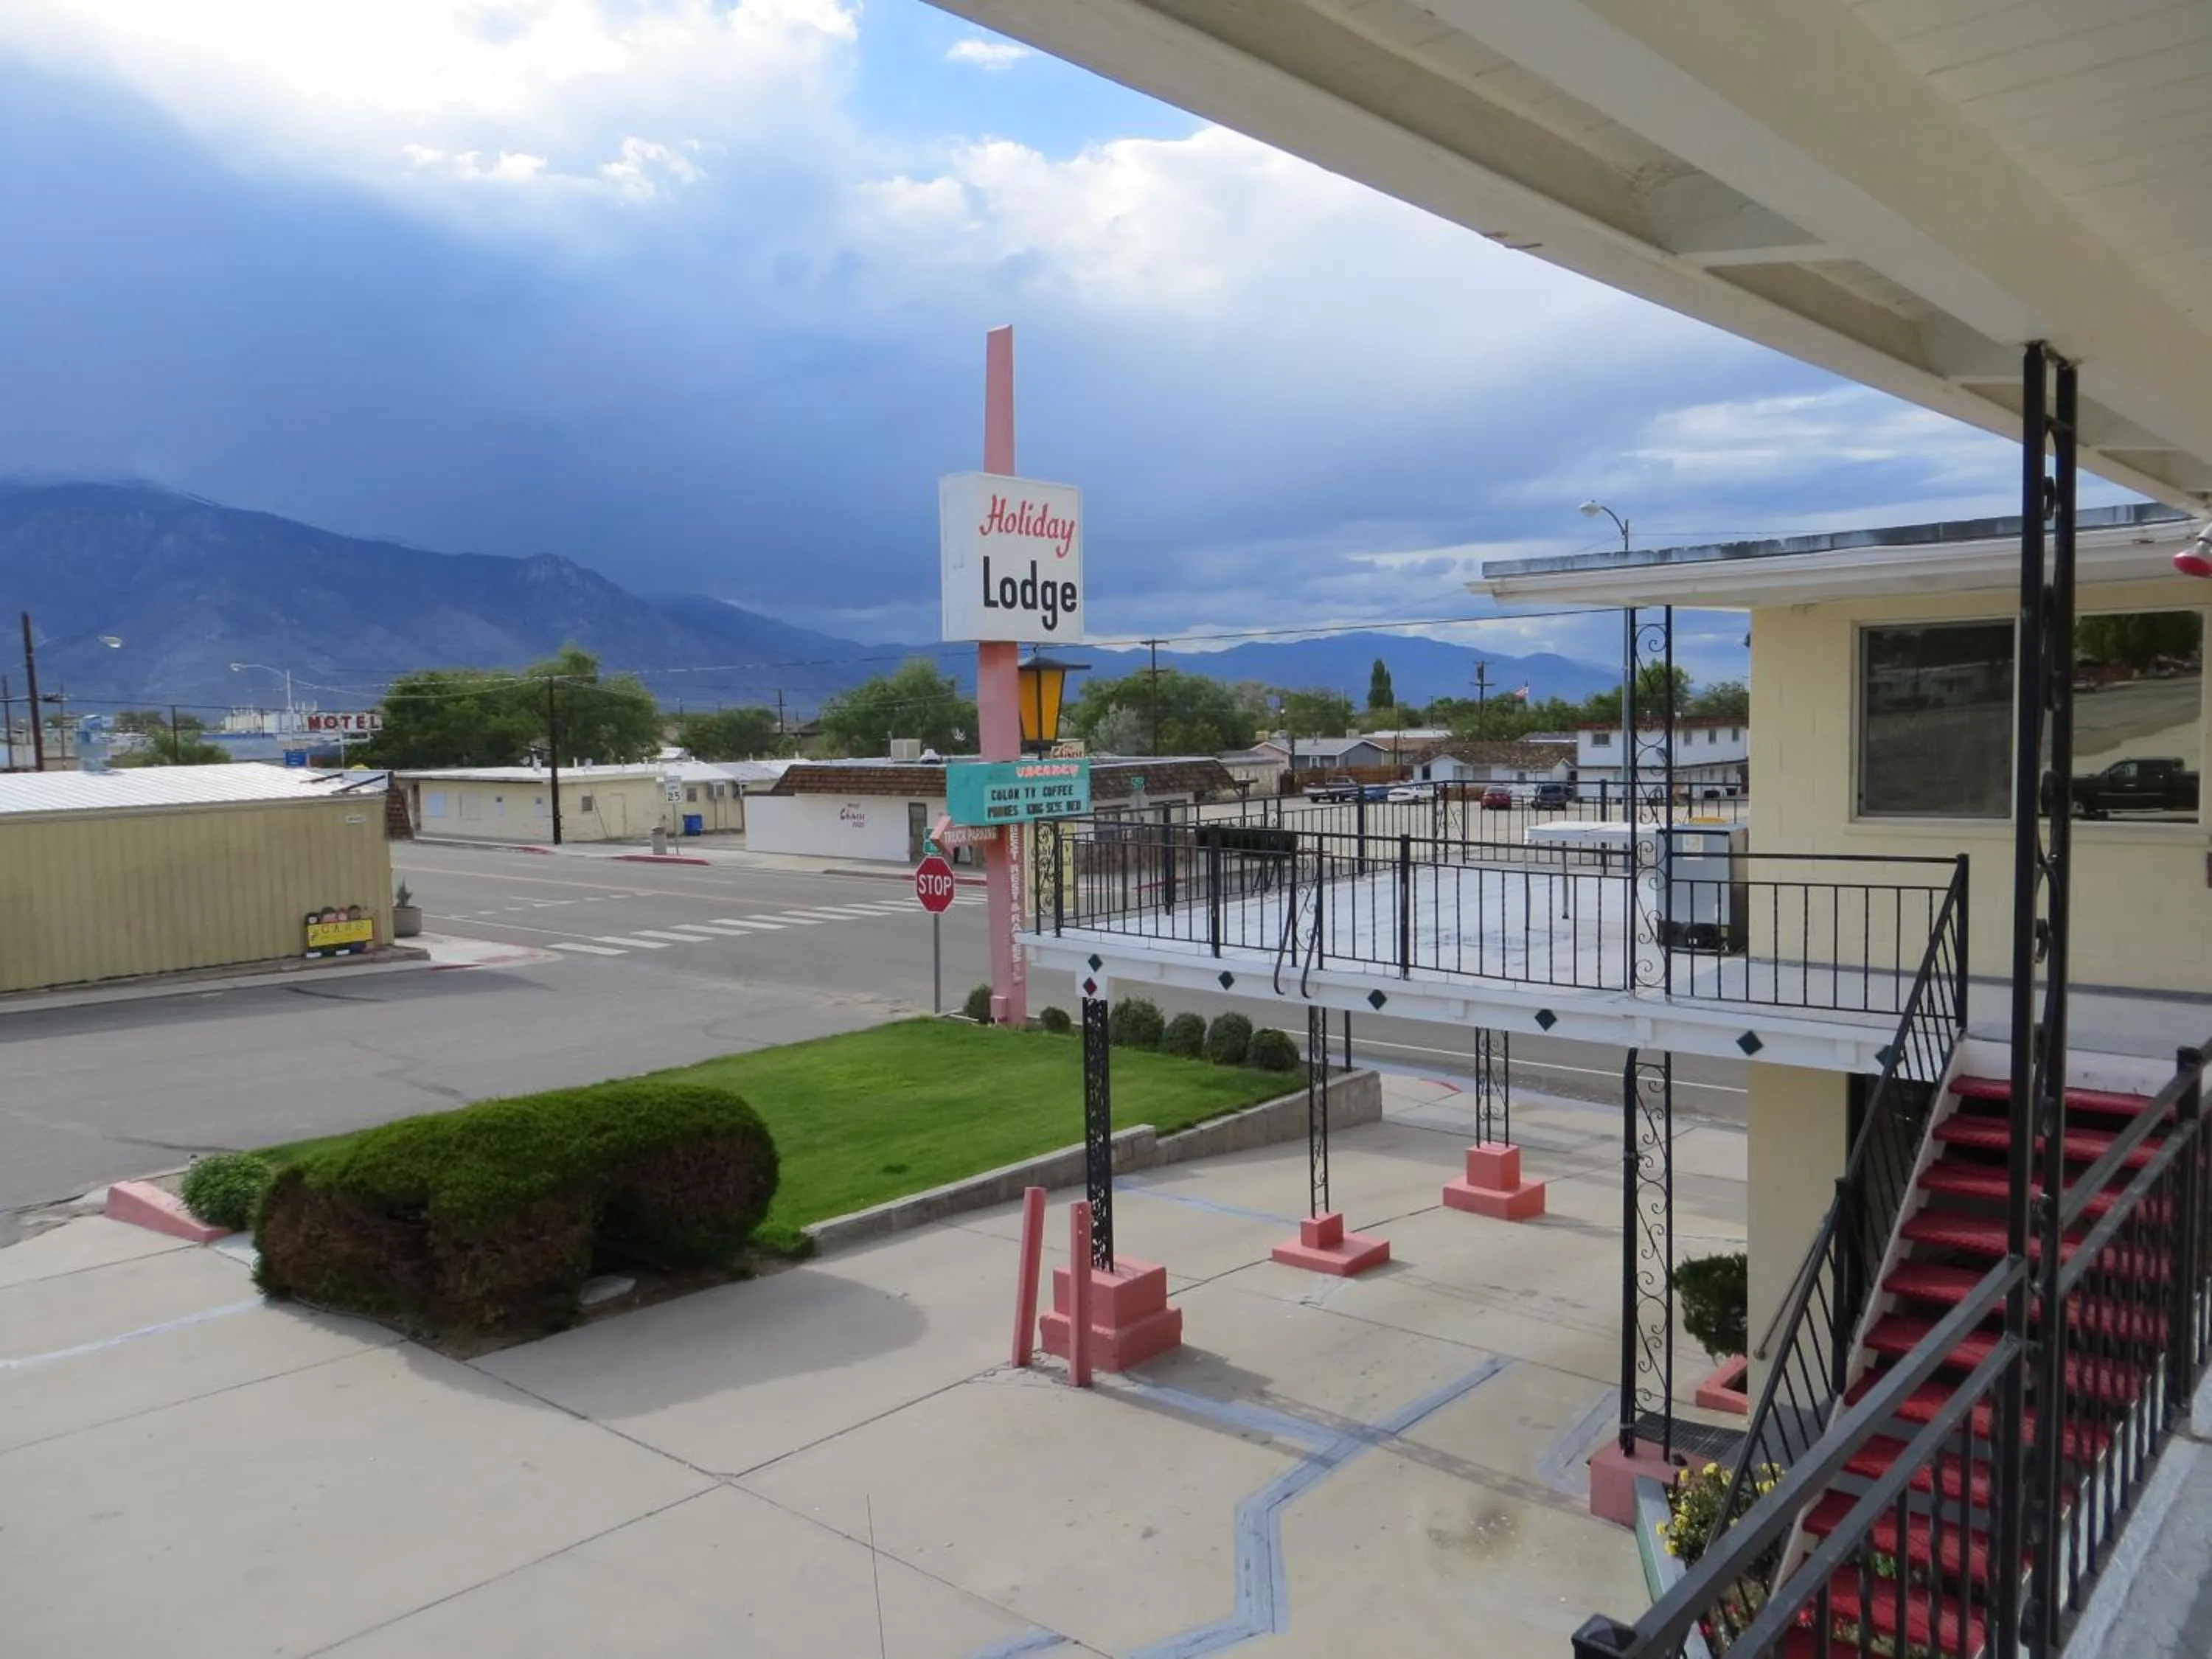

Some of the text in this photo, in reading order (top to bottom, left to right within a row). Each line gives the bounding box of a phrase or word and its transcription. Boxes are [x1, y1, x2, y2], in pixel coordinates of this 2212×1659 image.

[979, 494, 1075, 559] Holiday
[983, 555, 1078, 631] Lodge
[307, 716, 380, 730] MOTEL
[668, 791, 681, 801] 25
[991, 784, 1074, 801] COLOR TV COFFEE
[943, 829, 967, 844] TRUCK
[967, 827, 998, 841] PARKING
[918, 874, 952, 896] STOP
